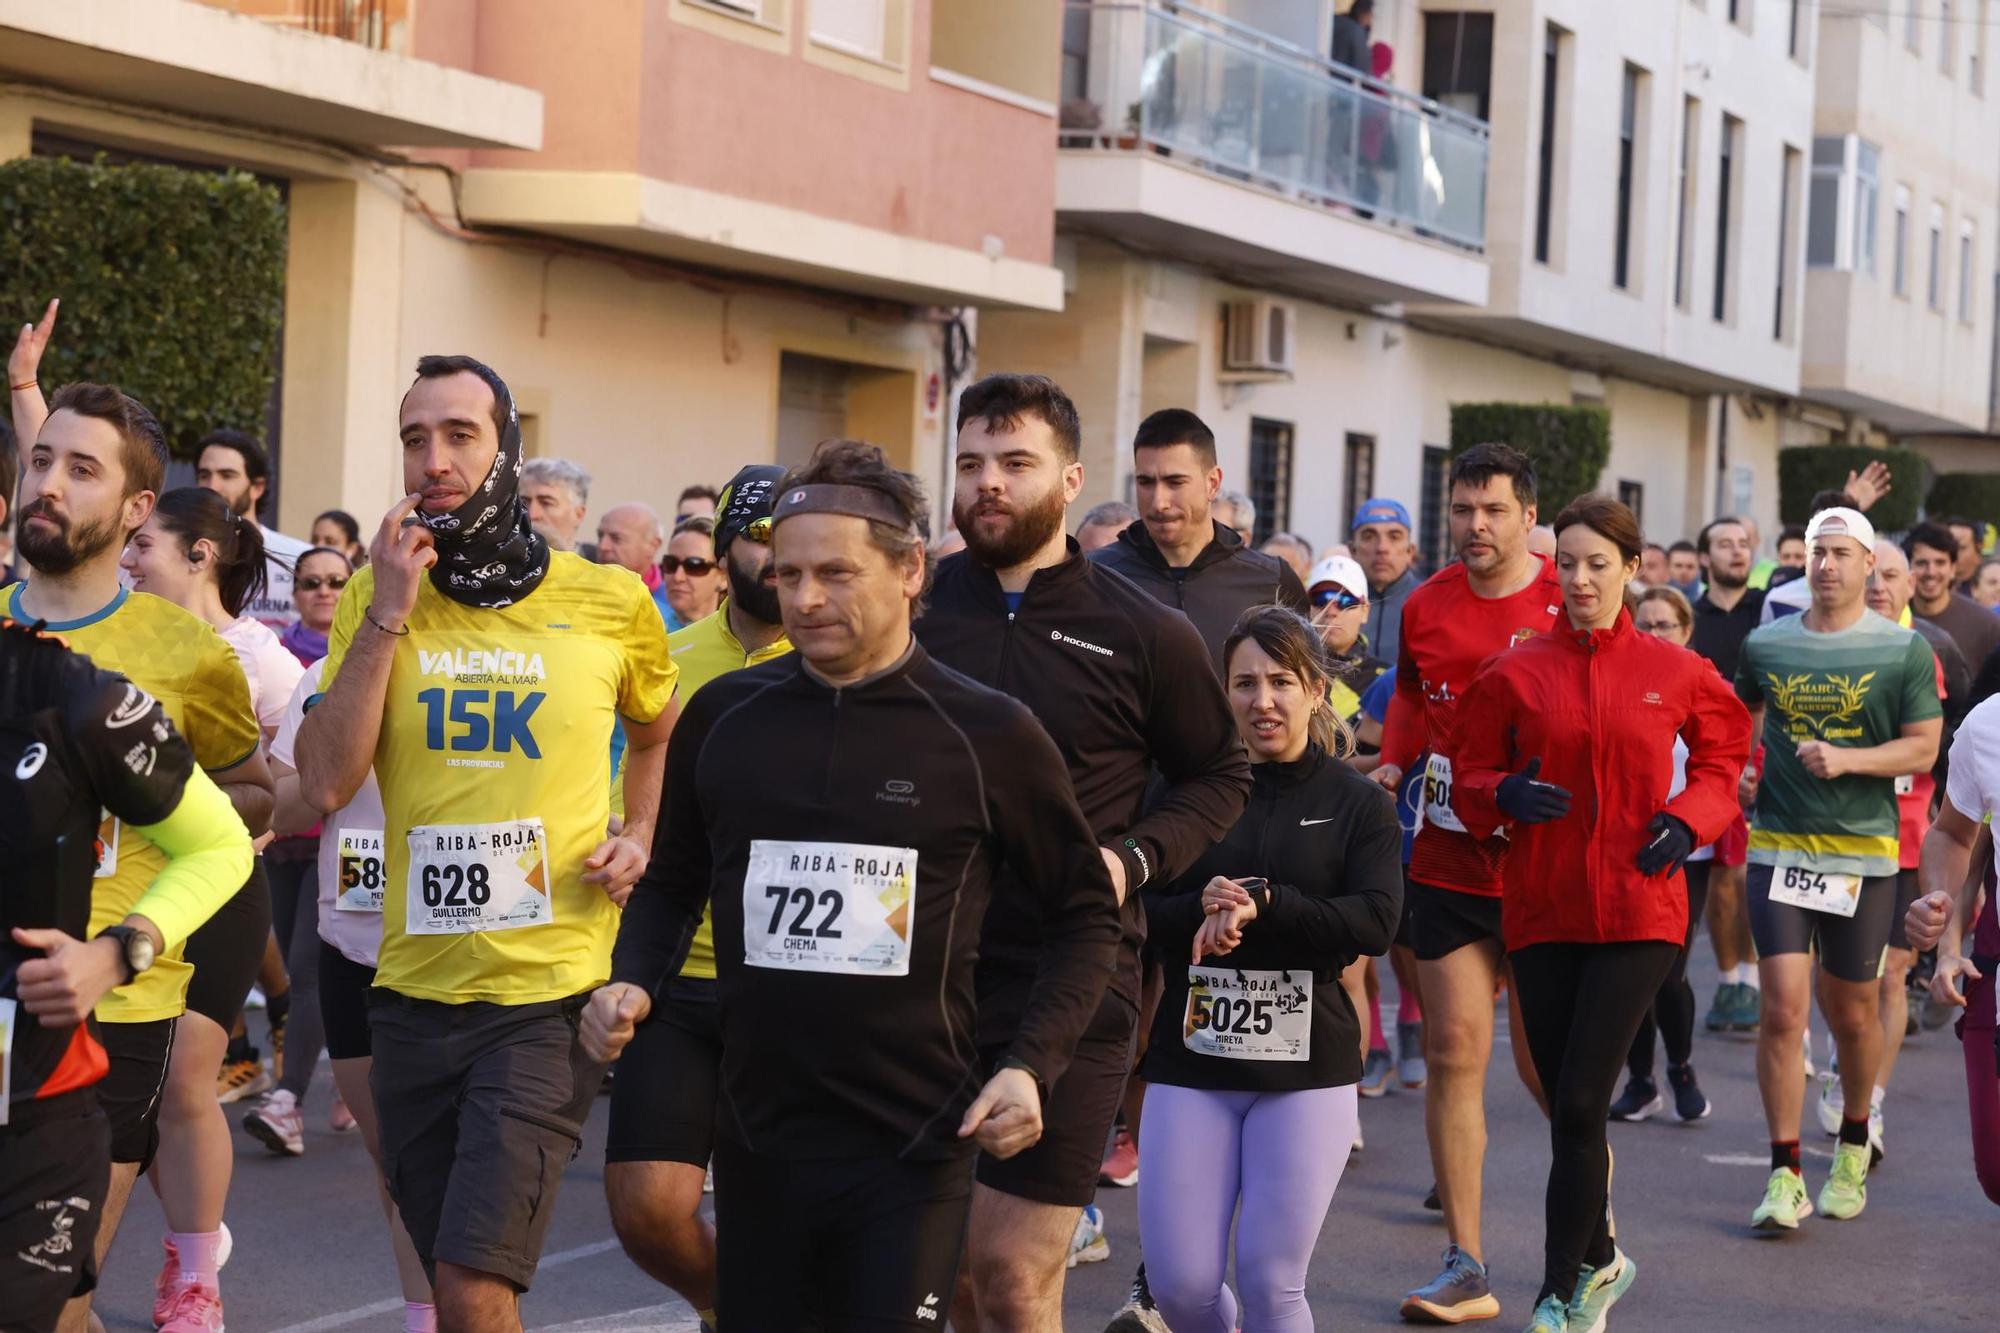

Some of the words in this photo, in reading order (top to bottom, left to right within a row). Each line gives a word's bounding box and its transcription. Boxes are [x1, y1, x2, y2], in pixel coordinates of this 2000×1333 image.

[417, 647, 546, 679] VALENCIA
[454, 673, 495, 684] ABIERTA
[496, 674, 510, 685] AL
[512, 675, 538, 686] MAR
[417, 687, 547, 760] 15K
[446, 758, 461, 767] LAS
[461, 759, 505, 769] PROVINCIAS
[344, 837, 384, 851] RIBA
[436, 829, 537, 851] RIBA-ROJA
[790, 854, 905, 878] RIBA-ROJA
[422, 863, 491, 907] 628
[1784, 867, 1827, 895] 654
[432, 906, 481, 919] GUILLERMO
[765, 885, 844, 939] 722
[783, 938, 818, 951] CHEMA
[1191, 994, 1273, 1036] 5025
[1215, 1034, 1244, 1045] MIREYA
